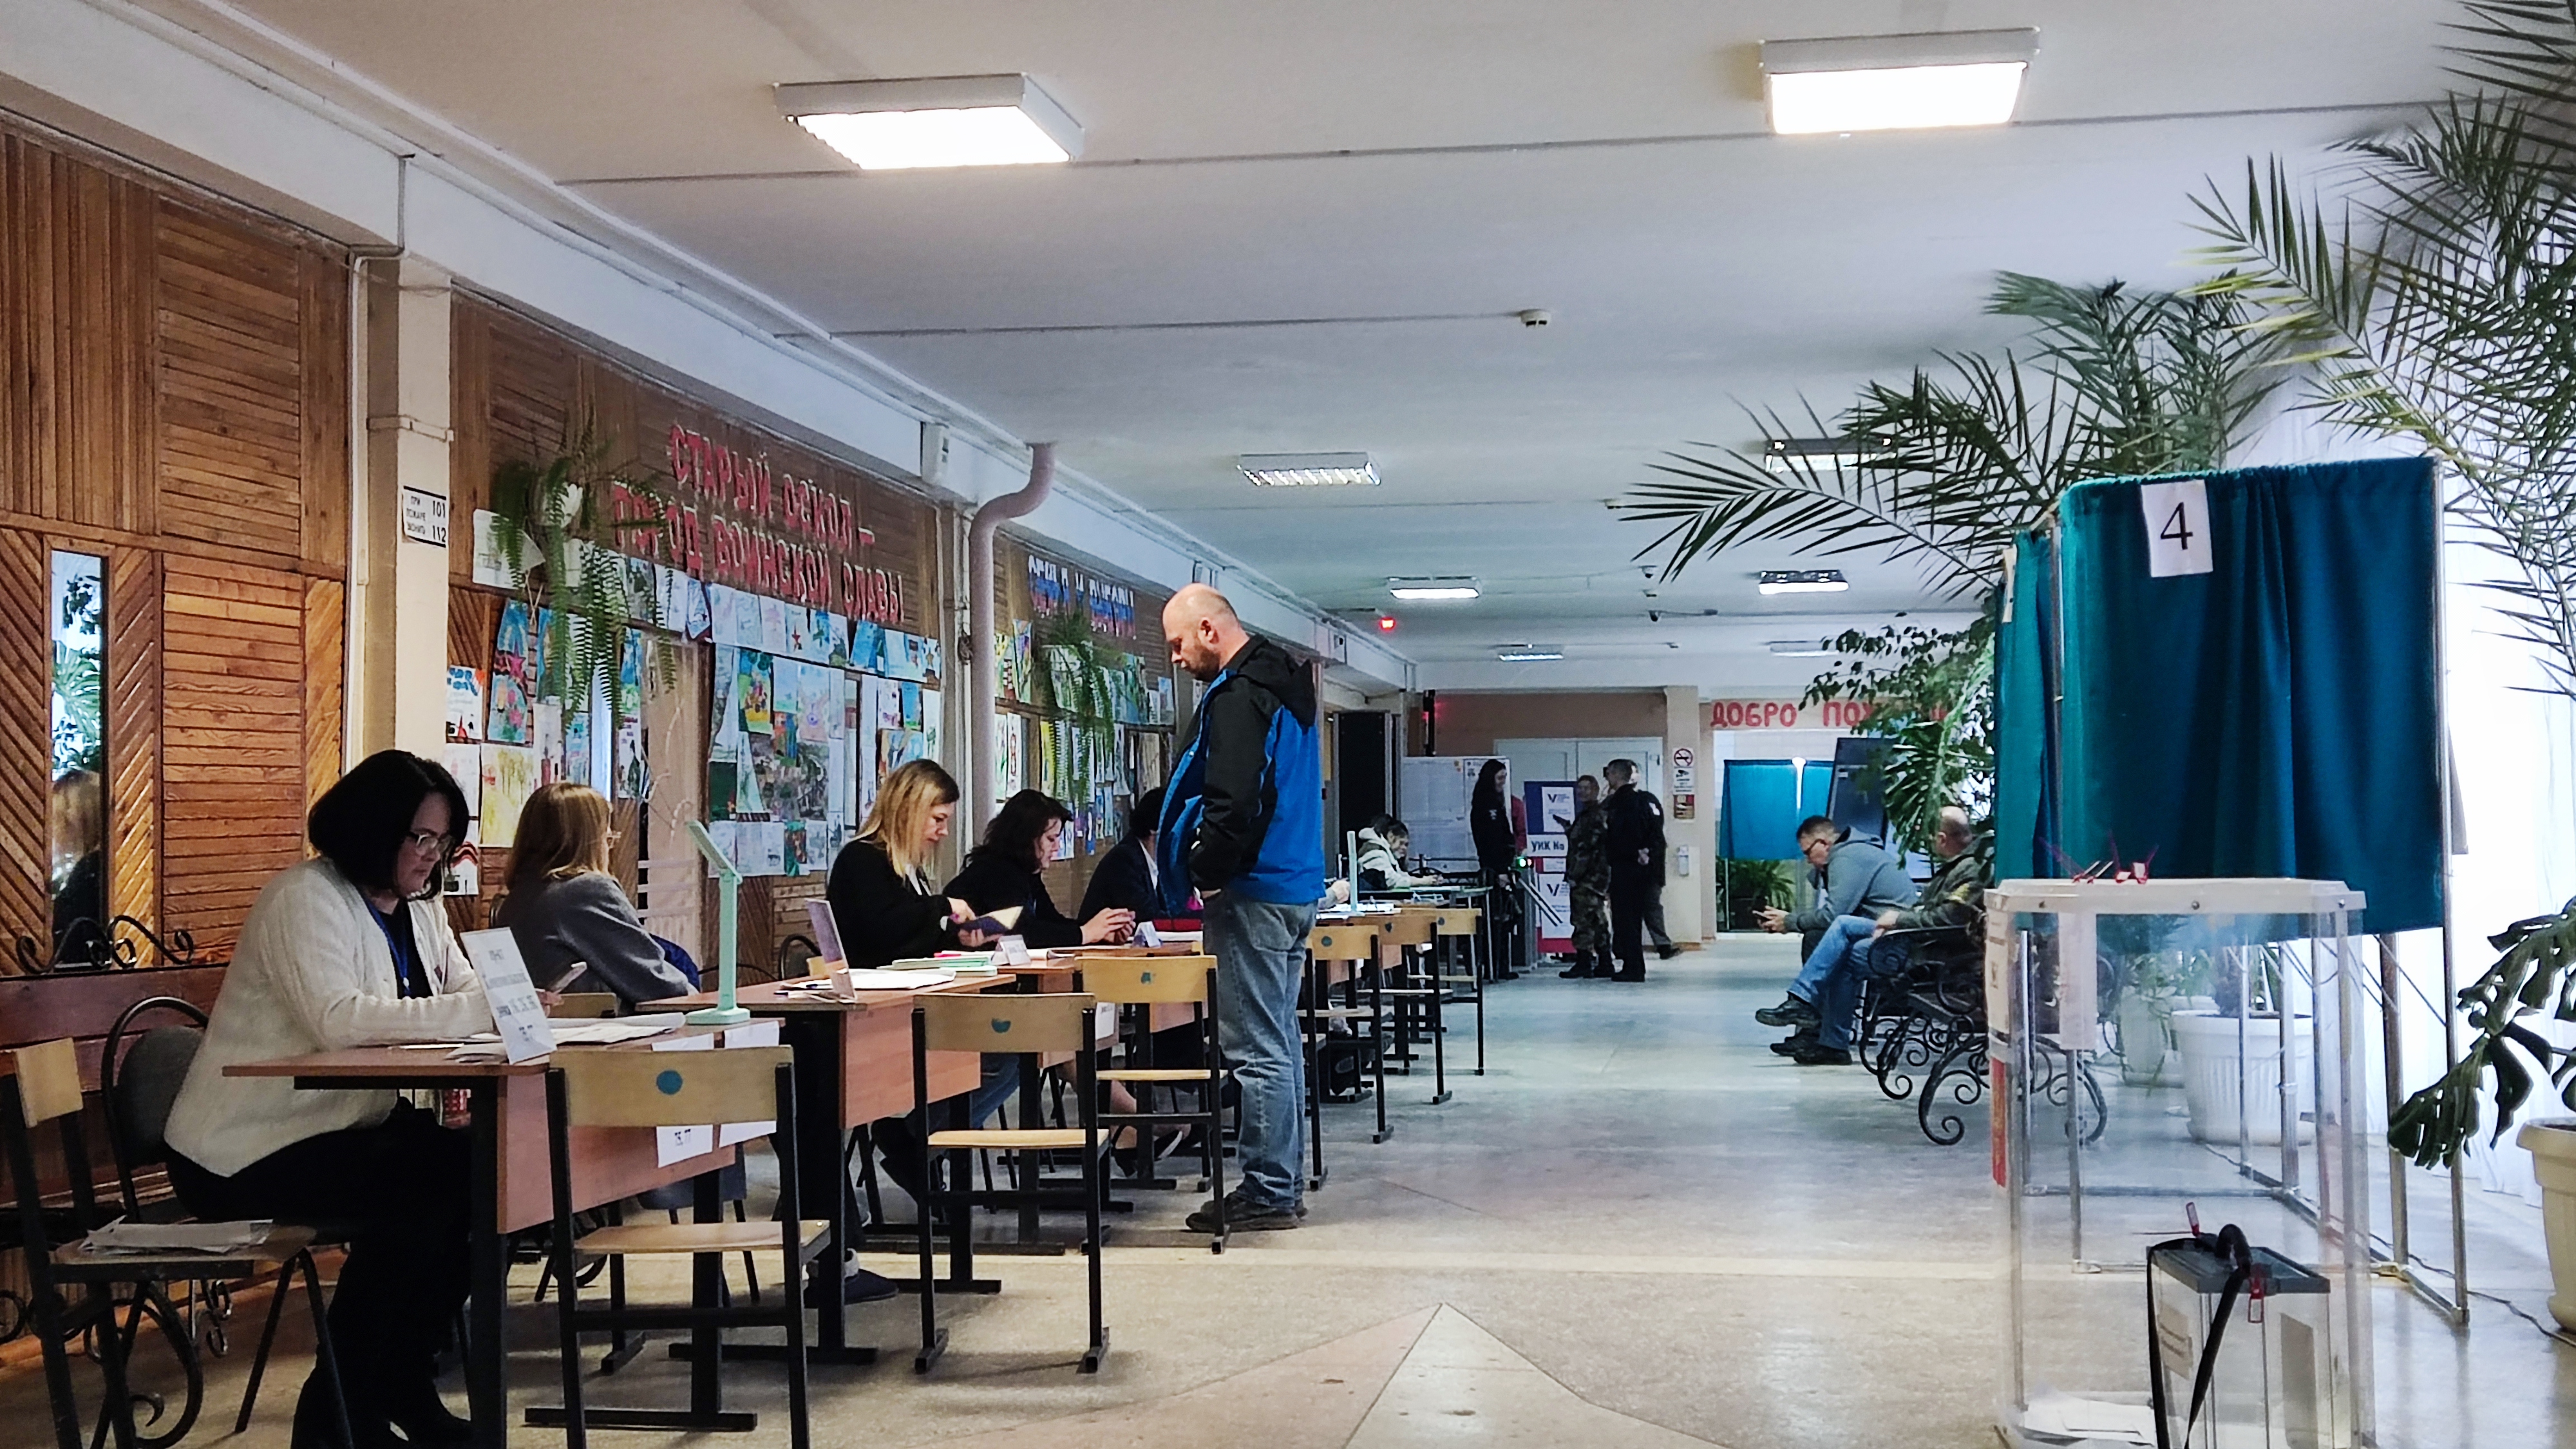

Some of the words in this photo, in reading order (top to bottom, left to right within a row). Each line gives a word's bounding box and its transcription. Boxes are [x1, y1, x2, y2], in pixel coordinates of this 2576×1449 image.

[433, 500, 446, 518] 101
[783, 473, 852, 553] ОСКОЛ
[432, 525, 446, 543] 112
[2160, 502, 2193, 551] 4
[712, 515, 831, 609] ВОИНСКОЙ
[842, 561, 904, 623] СЛАВЫ
[1710, 701, 1797, 728] ДОБРО
[1531, 840, 1551, 853] УИК
